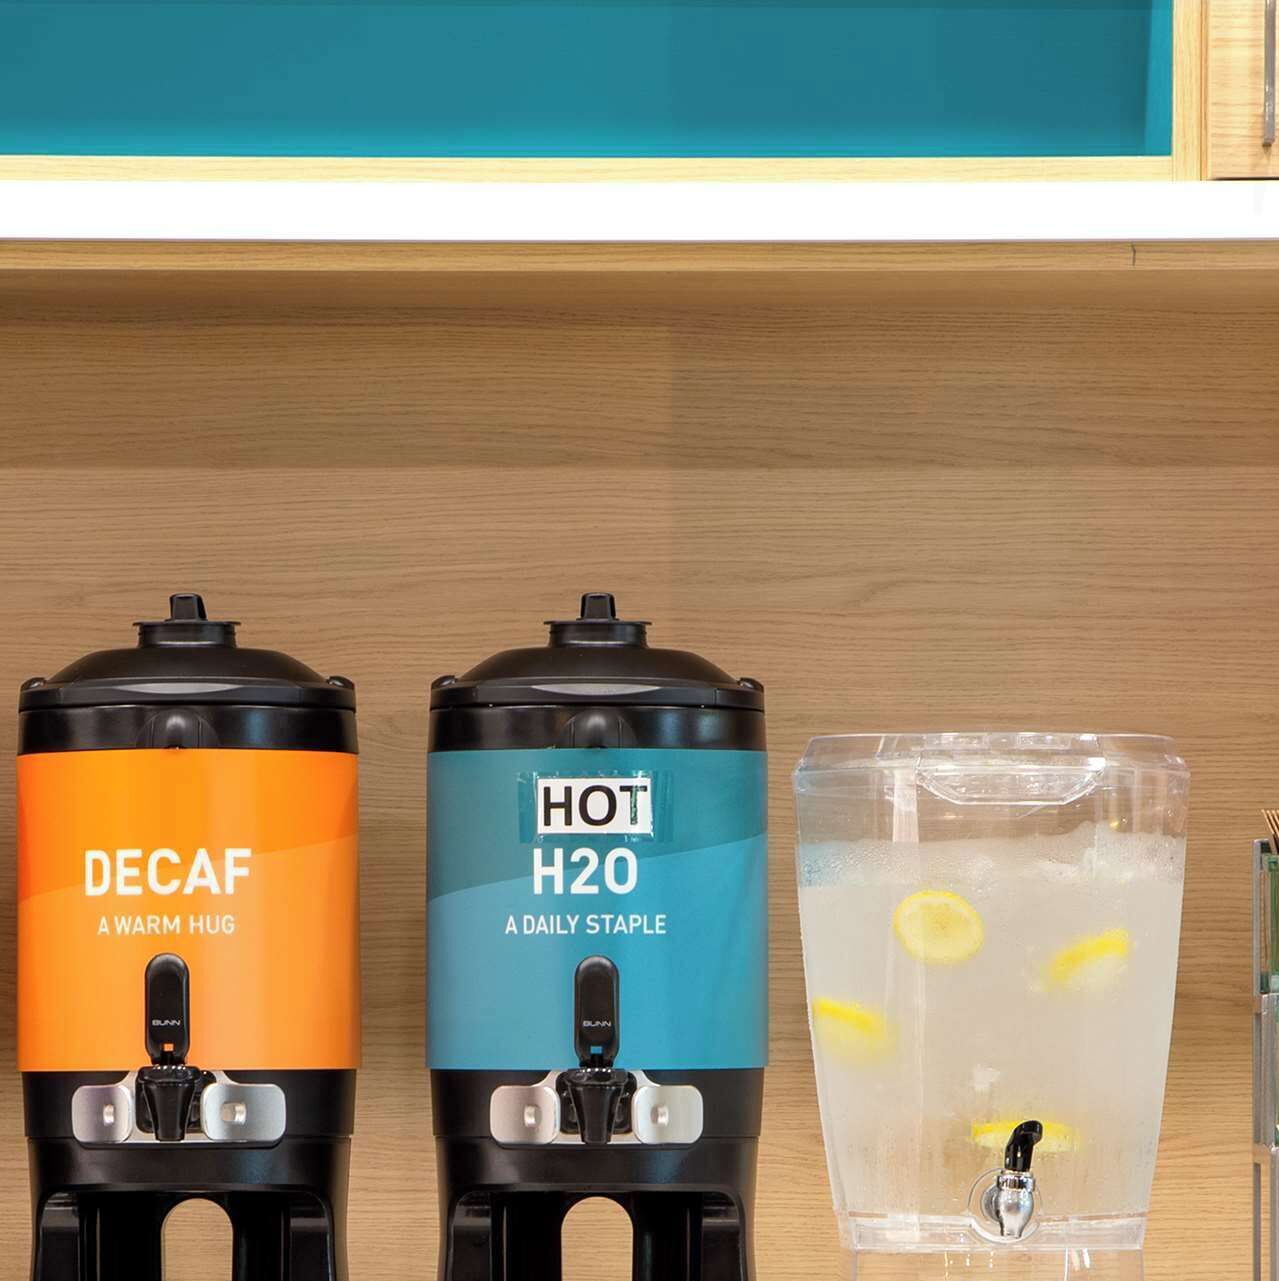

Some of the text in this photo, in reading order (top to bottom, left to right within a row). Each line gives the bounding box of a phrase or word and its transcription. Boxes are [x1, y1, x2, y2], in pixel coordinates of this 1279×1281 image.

[543, 784, 649, 826] HOT
[84, 848, 252, 897] DECAF
[97, 914, 235, 935] A WARM HUG
[505, 914, 666, 935] A DAILY STAPLE
